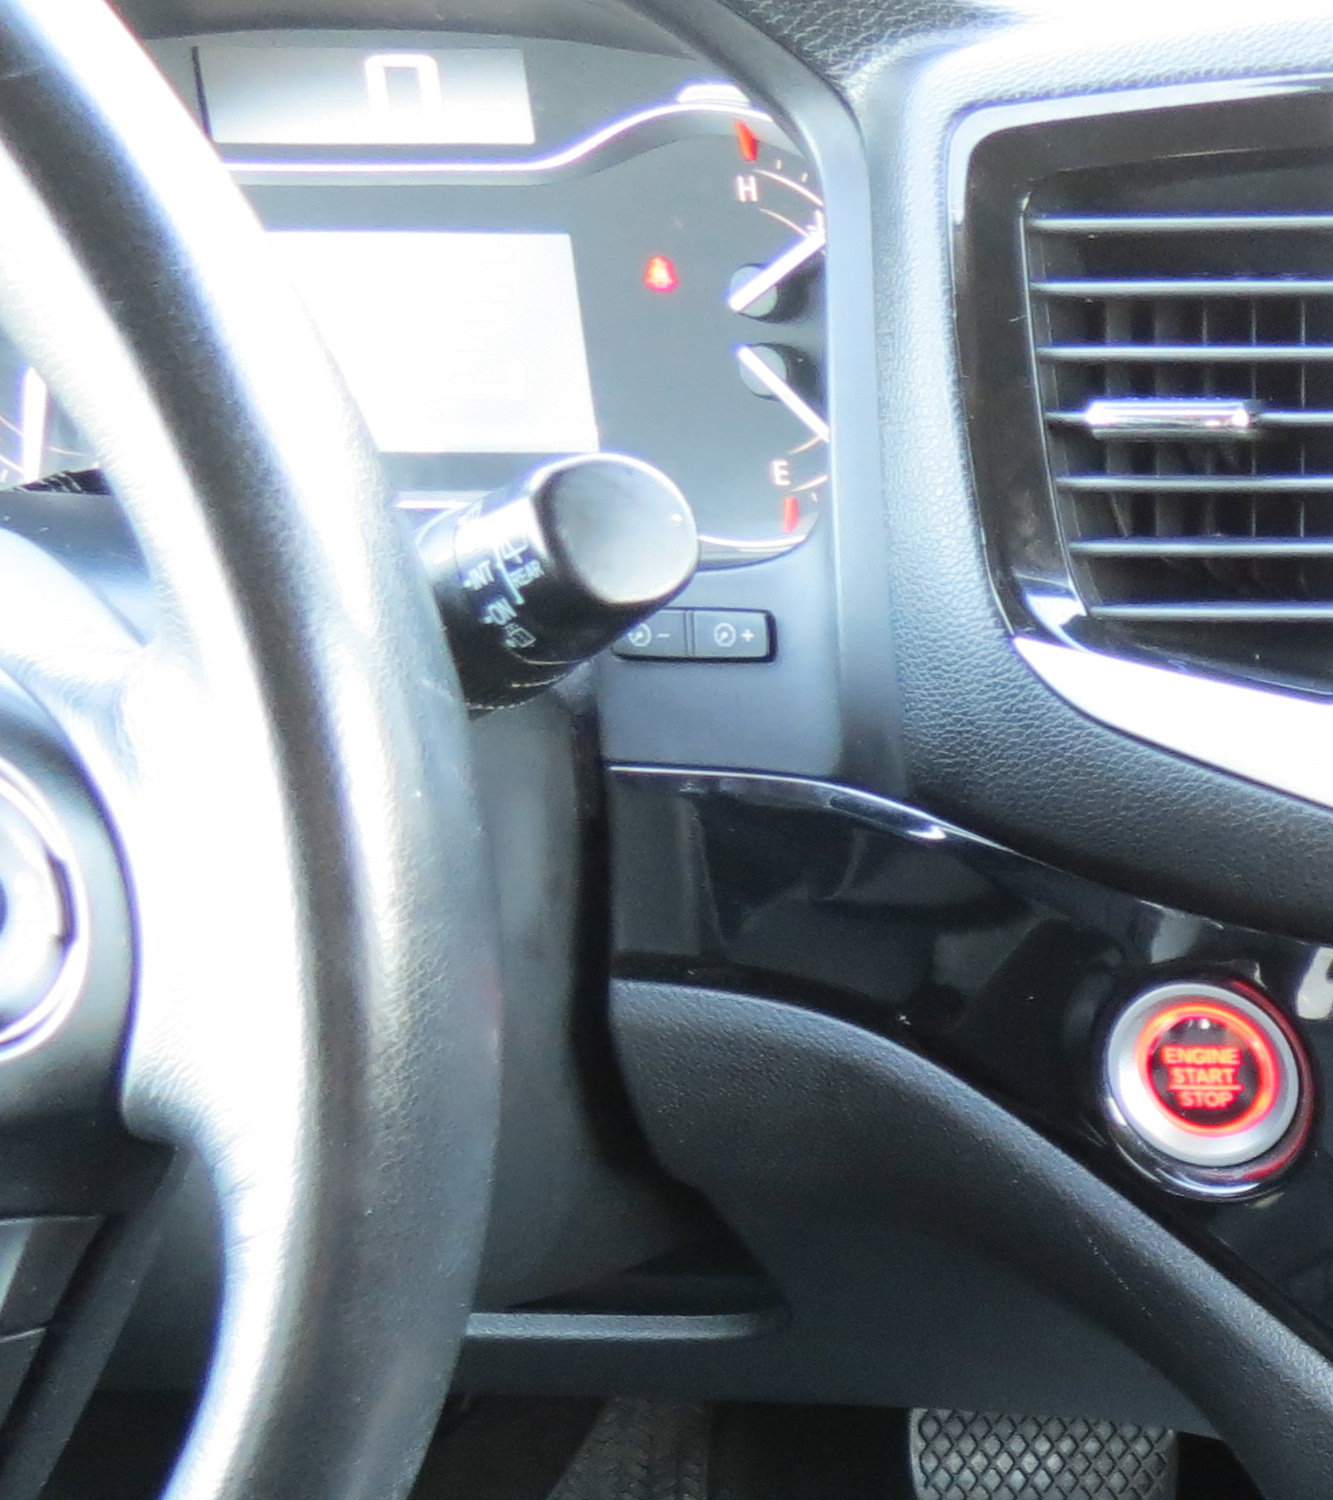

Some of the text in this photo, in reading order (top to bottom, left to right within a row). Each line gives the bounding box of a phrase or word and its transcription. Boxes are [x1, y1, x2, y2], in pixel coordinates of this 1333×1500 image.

[736, 175, 758, 202] H
[771, 459, 791, 487] E
[1164, 1046, 1241, 1065] ENGINE
[1170, 1067, 1236, 1084] START
[1179, 1091, 1234, 1107] STOP
